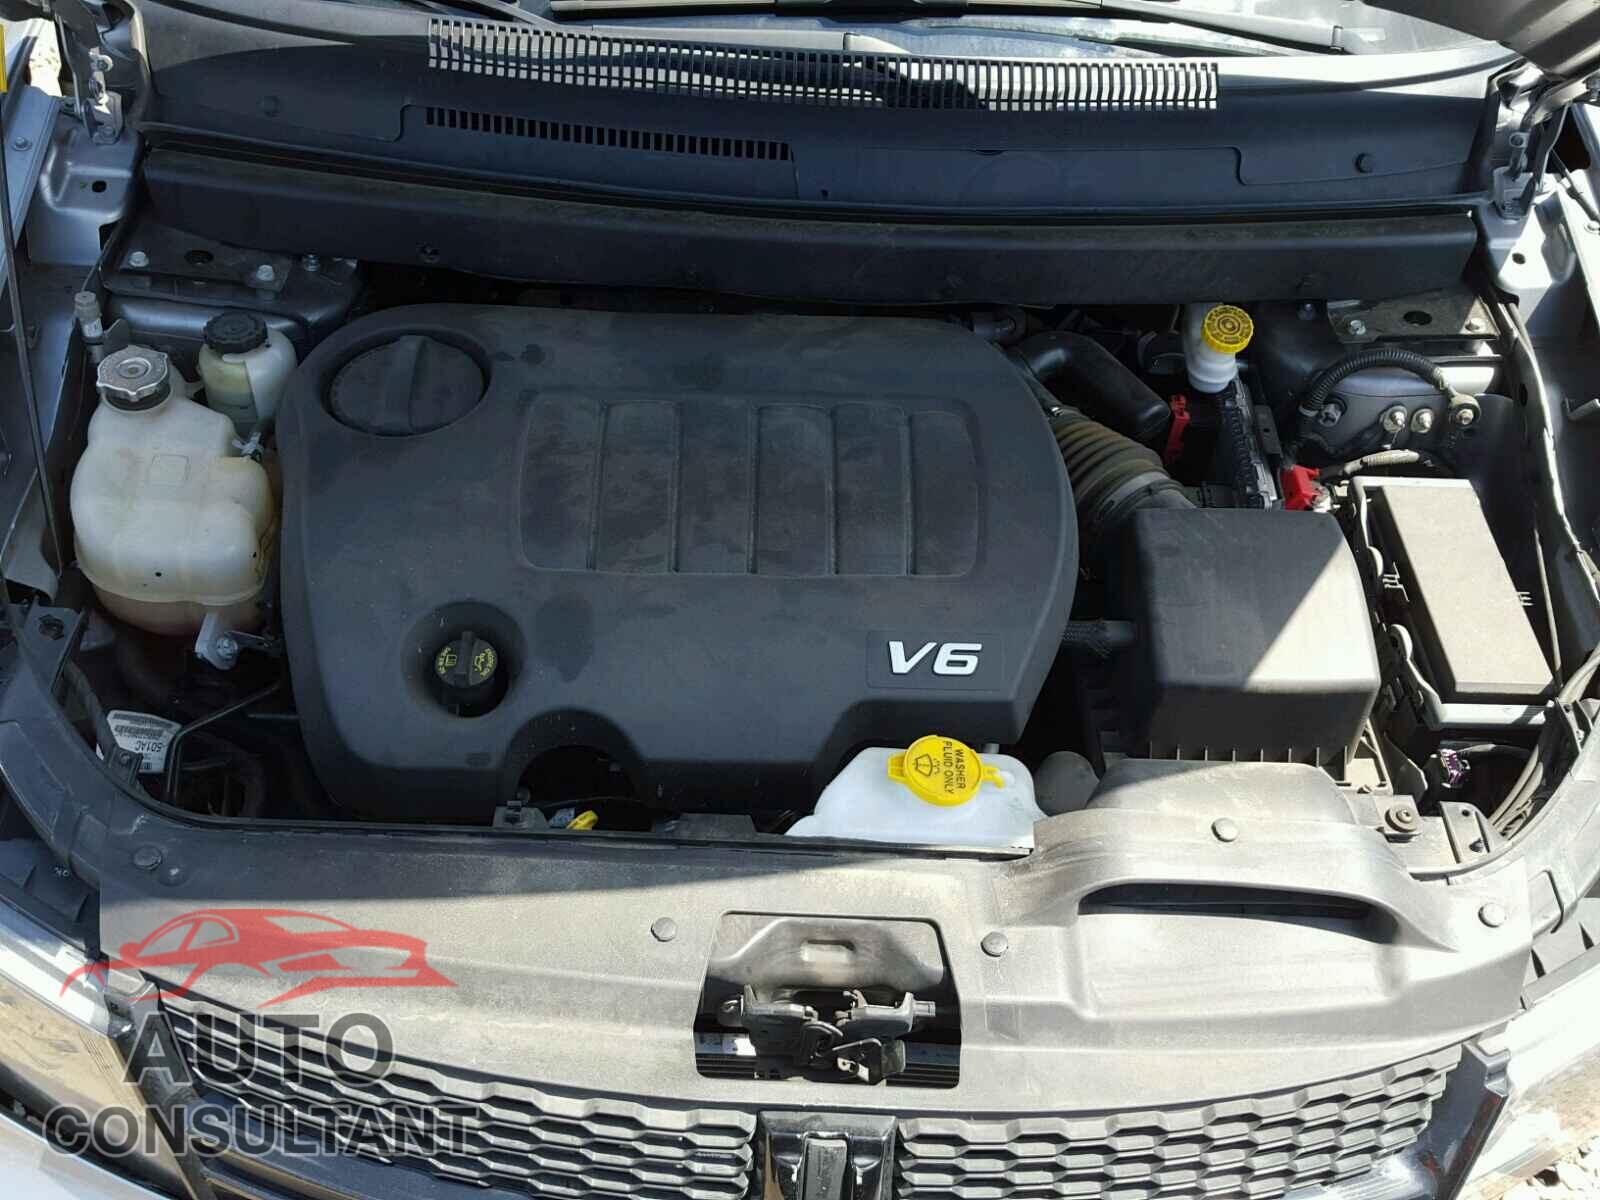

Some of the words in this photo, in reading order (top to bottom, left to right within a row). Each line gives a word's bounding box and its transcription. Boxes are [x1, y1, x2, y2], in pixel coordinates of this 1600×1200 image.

[888, 640, 983, 675] V6
[943, 740, 953, 767] FLUID
[954, 749, 967, 789] WASHER
[943, 770, 954, 794] ONLY
